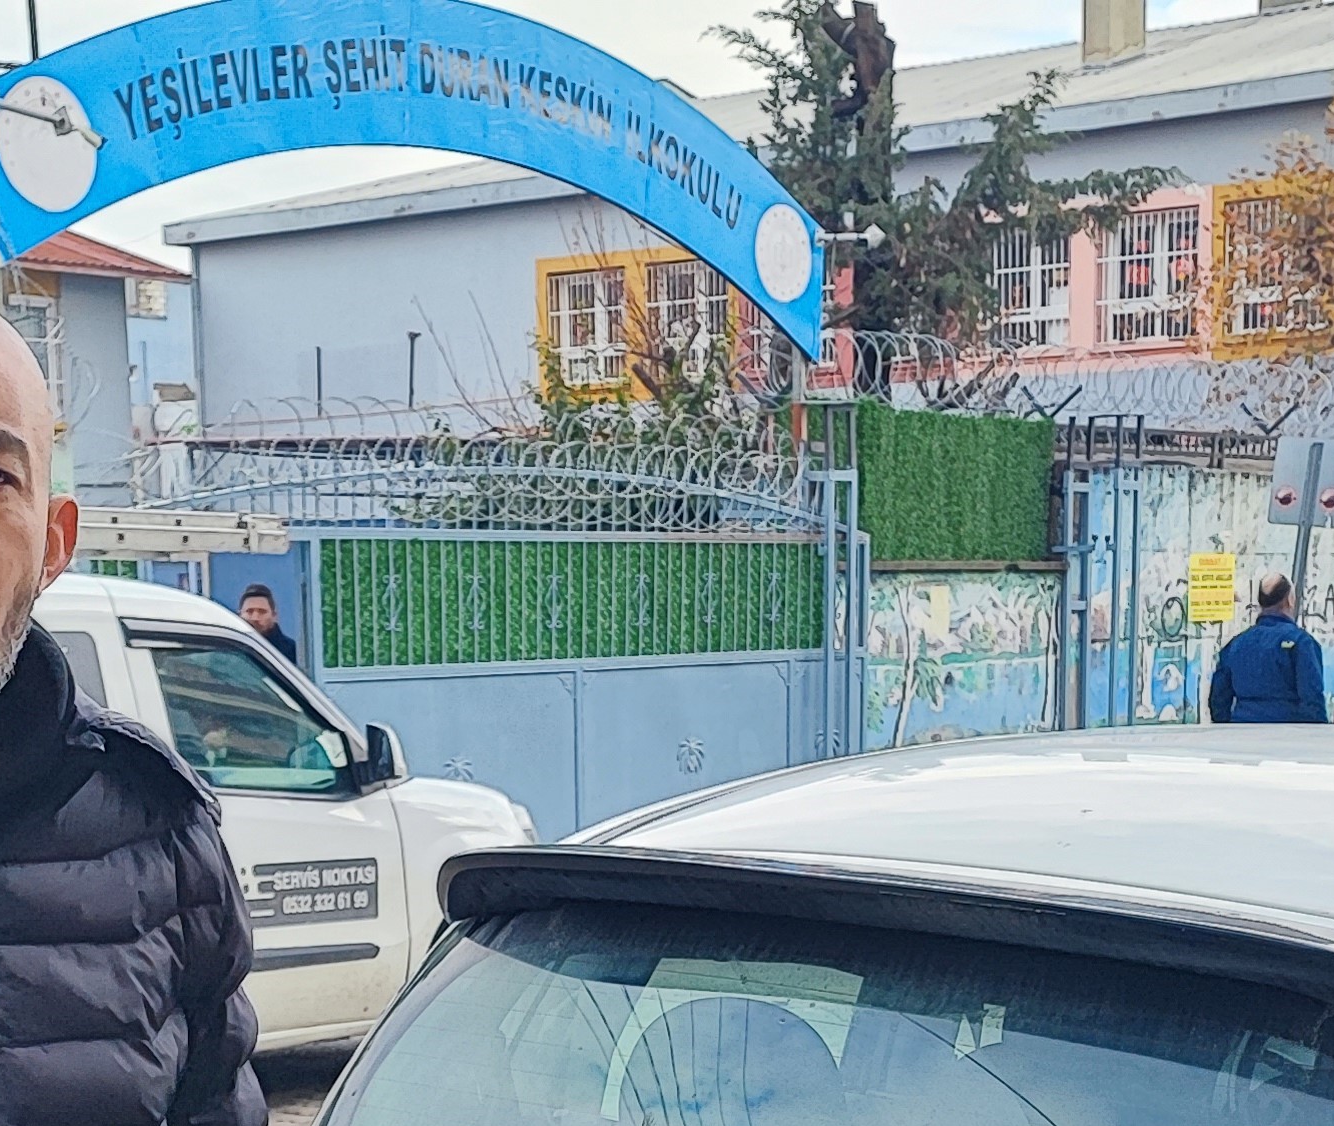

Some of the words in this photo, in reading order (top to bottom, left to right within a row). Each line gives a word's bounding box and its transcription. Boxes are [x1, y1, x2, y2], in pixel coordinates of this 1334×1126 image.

[114, 46, 313, 140] YEŞİLEVLER
[323, 25, 407, 109] ŞEHİT
[419, 43, 511, 109] DURAN
[517, 63, 613, 139] KESKİN
[626, 99, 742, 230] İLKOKULU
[273, 866, 320, 890] SERVİS
[322, 865, 376, 887] NOKTASI
[282, 894, 312, 915] 0532
